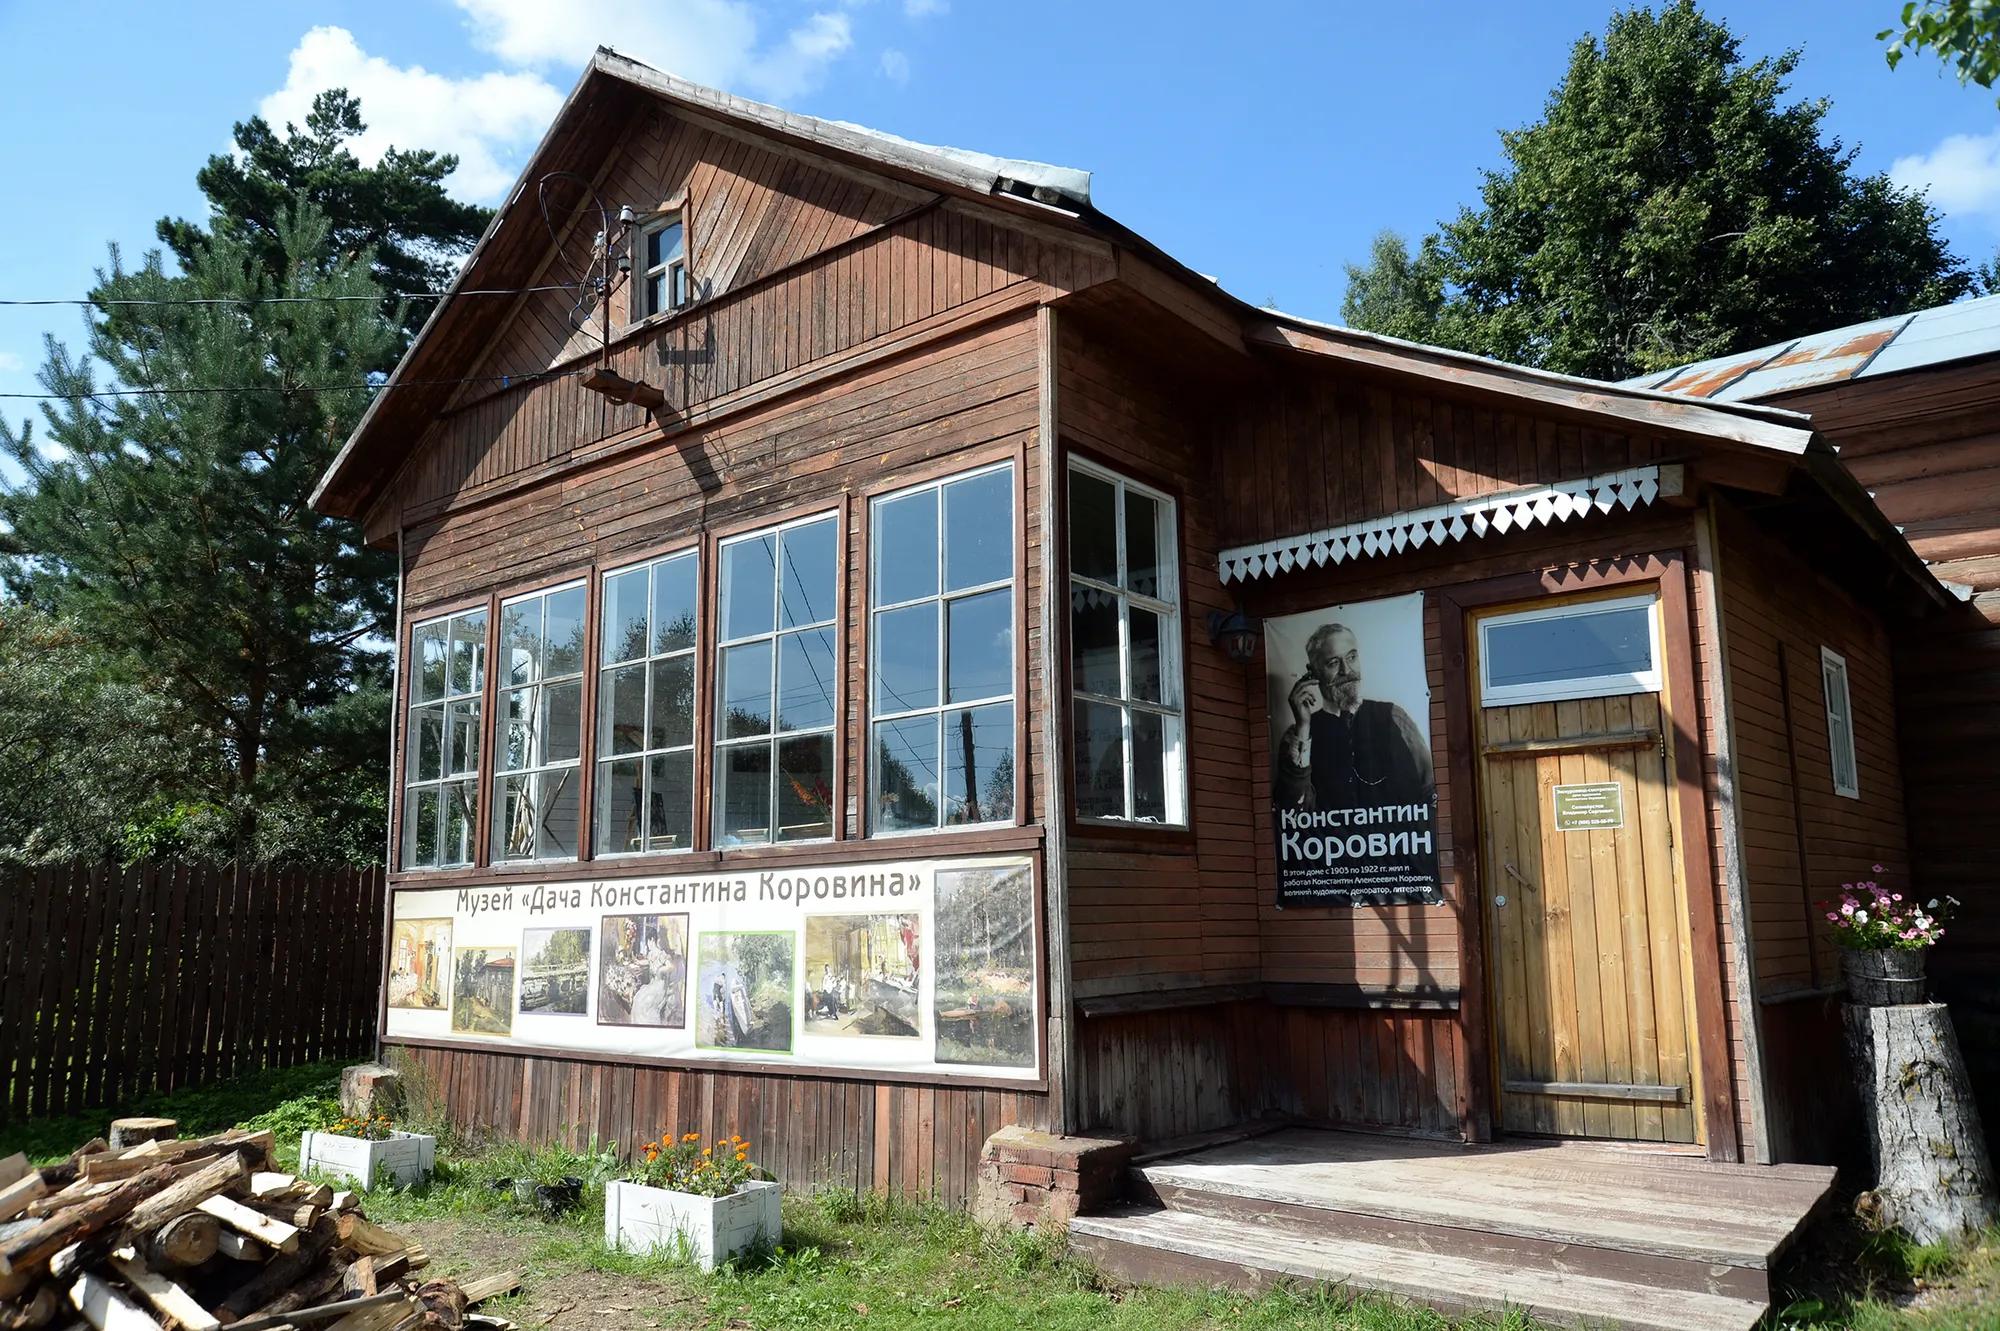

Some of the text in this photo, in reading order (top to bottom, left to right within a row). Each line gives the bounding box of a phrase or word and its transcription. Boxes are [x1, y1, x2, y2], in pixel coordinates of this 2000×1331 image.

[1281, 803, 1429, 830] Константин
[1281, 830, 1432, 867] Коровин
[1361, 865, 1379, 873] 1922
[1284, 879, 1311, 887] работал
[1354, 876, 1398, 884] Алексеевич
[1398, 875, 1434, 883] Коровин,
[456, 872, 921, 917] Музей «Дача Константина Коровина»
[1284, 886, 1432, 897] великий художник, декоратор, литератор
